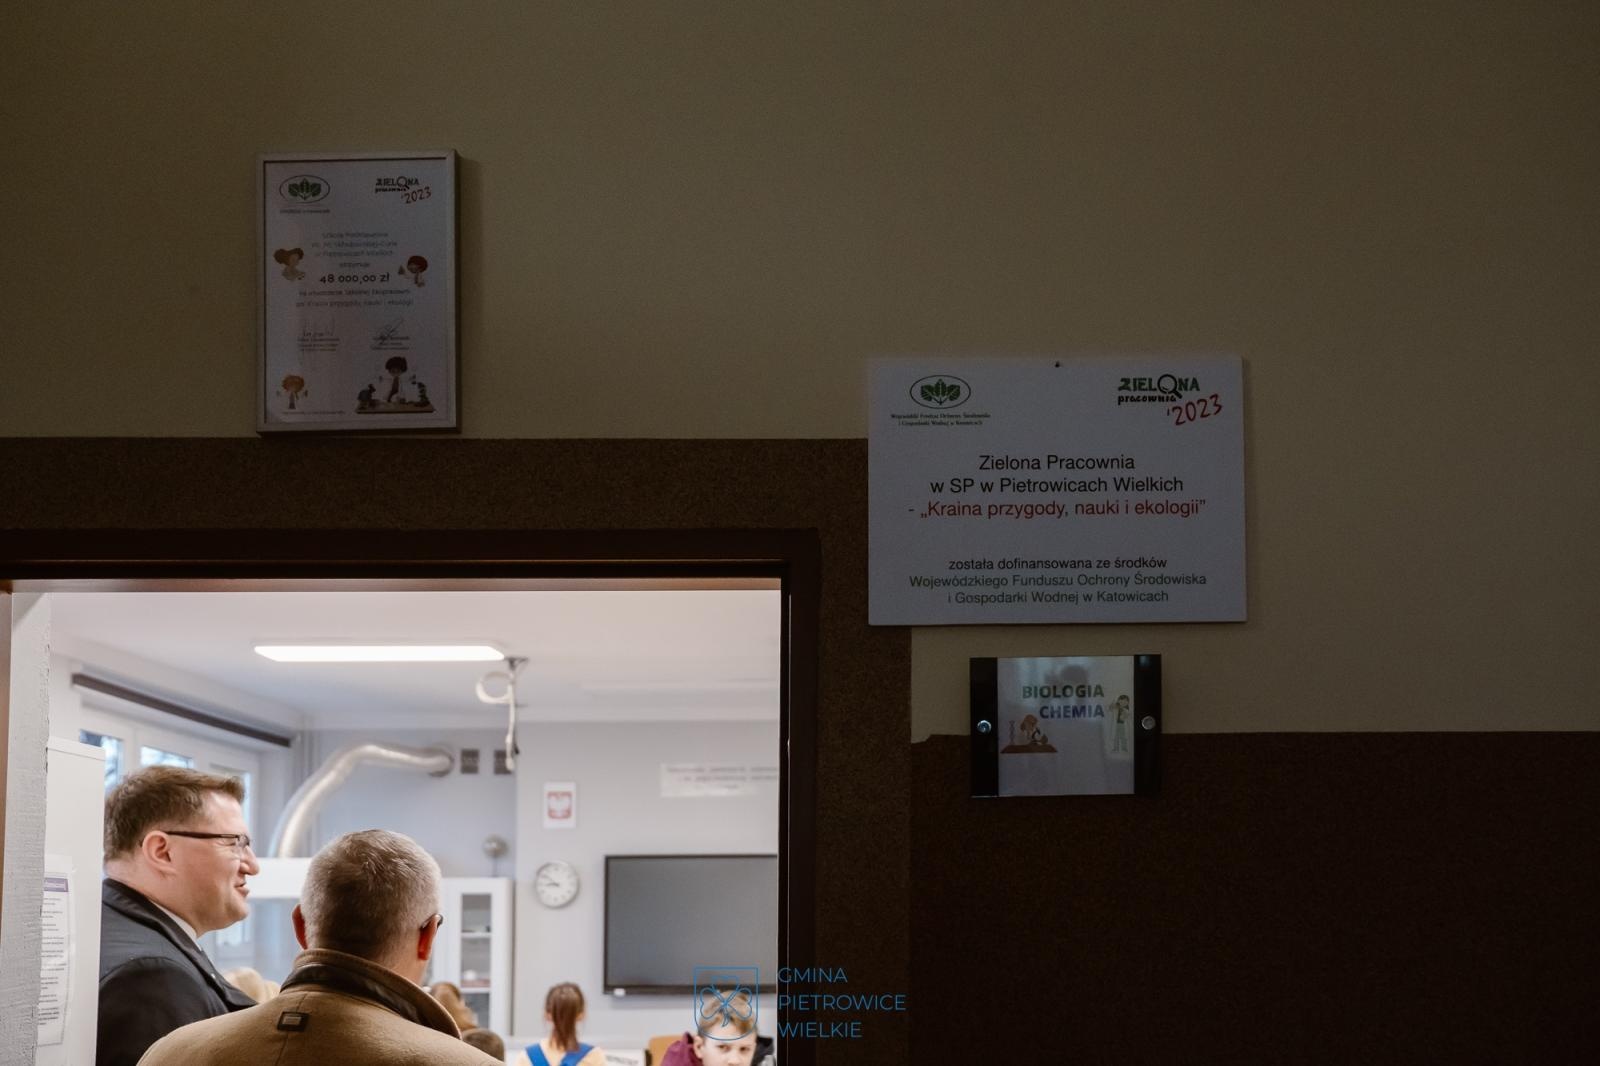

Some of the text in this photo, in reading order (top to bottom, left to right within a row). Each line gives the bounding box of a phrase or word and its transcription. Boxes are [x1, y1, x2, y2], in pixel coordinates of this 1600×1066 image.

[320, 273, 390, 285] 48 000,00 zł
[1118, 374, 1200, 394] ZIELONA
[1118, 395, 1176, 405] pracownia
[979, 454, 1135, 470] Zielona Pracownia
[930, 476, 1183, 493] w SP w Pietrowicach Wielkich
[988, 500, 1068, 519] przygody,
[1075, 499, 1120, 515] nauki
[1125, 500, 1129, 514] i
[949, 556, 1168, 570] została dofinansowana ze środków
[909, 571, 1207, 589] Wojewódzkiego Funduszu Ochrony Środowiska
[955, 591, 1027, 607] Gospodarki
[1031, 591, 1079, 606] Wodnej
[1083, 592, 1093, 602] w
[1097, 590, 1169, 602] Katowicach
[1022, 685, 1104, 699] BIOLOGIA
[1039, 705, 1104, 719] CHEMIA
